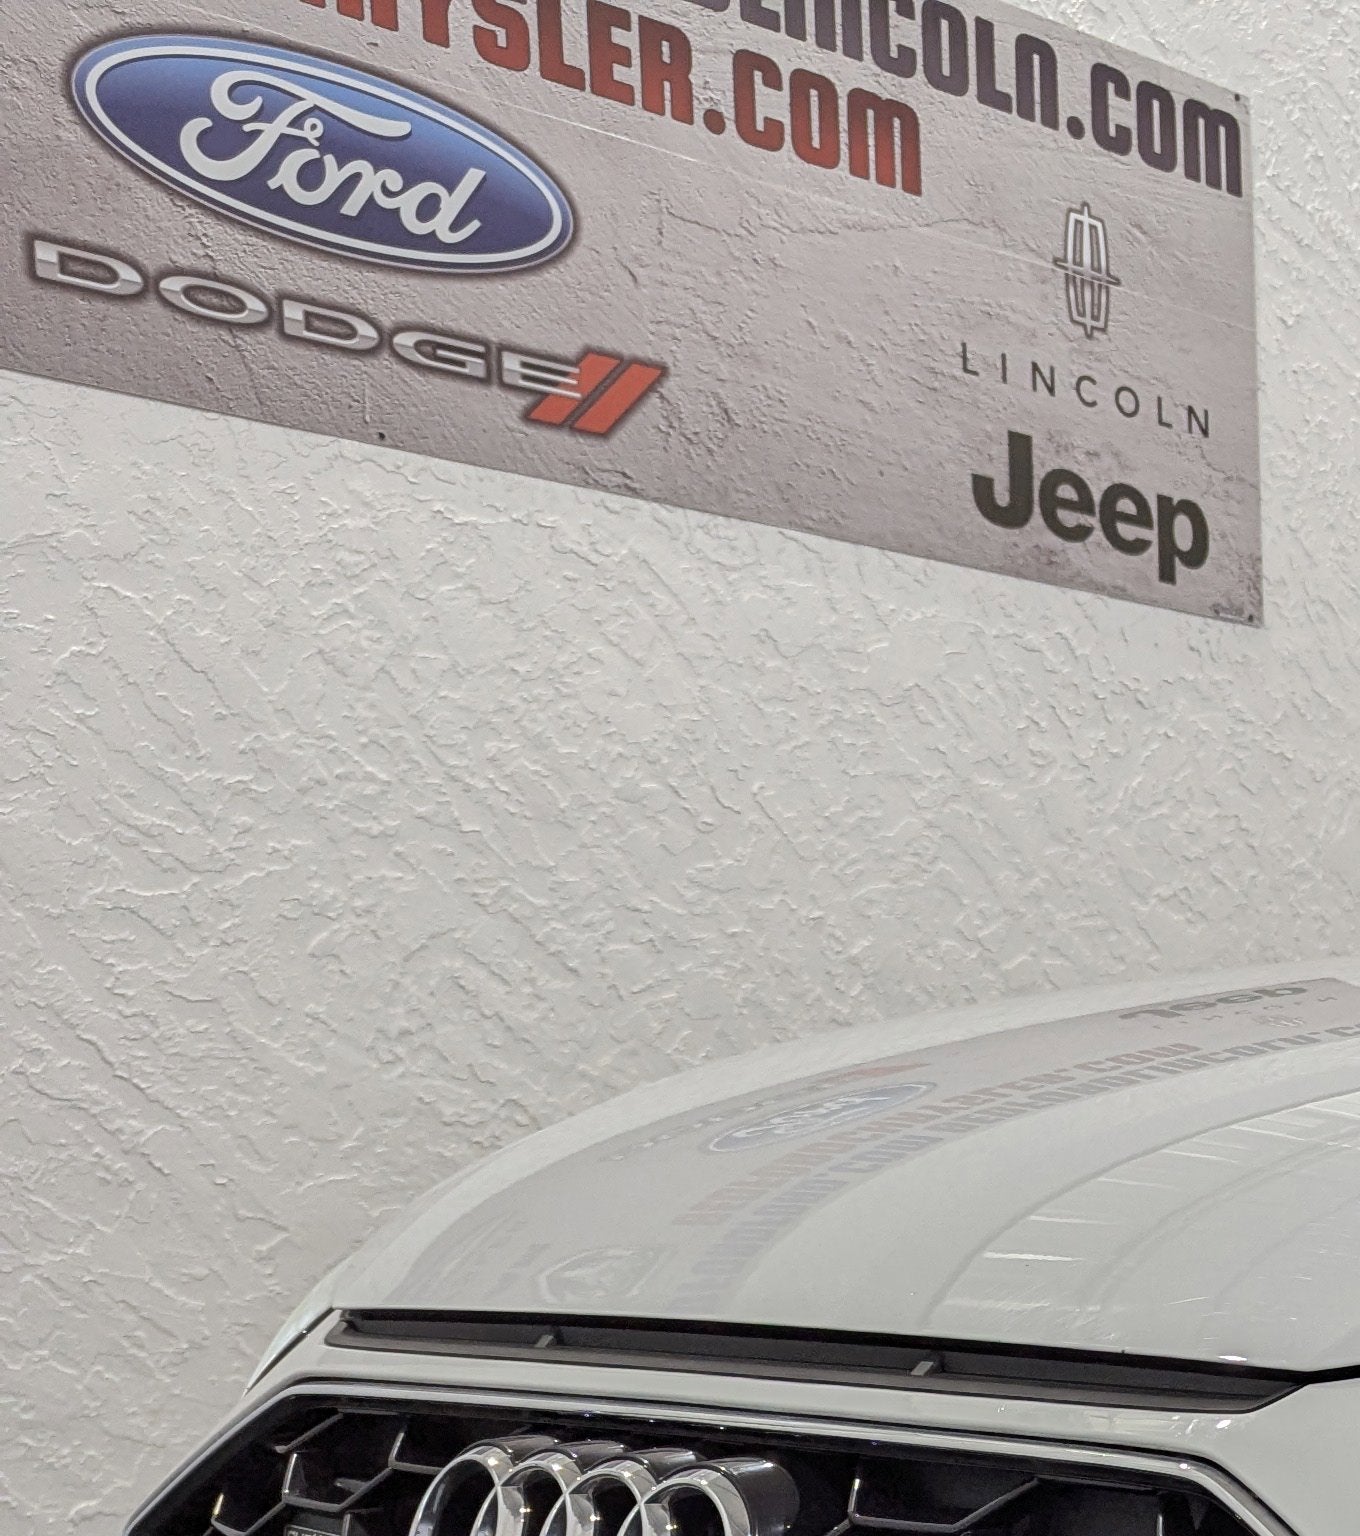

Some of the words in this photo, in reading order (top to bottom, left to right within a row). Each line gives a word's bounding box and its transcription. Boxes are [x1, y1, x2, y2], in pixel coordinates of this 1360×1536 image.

[180, 70, 487, 244] Ford
[33, 239, 582, 400] DODGE
[961, 342, 1209, 438] LINCOLN
[971, 430, 1209, 585] Jeep
